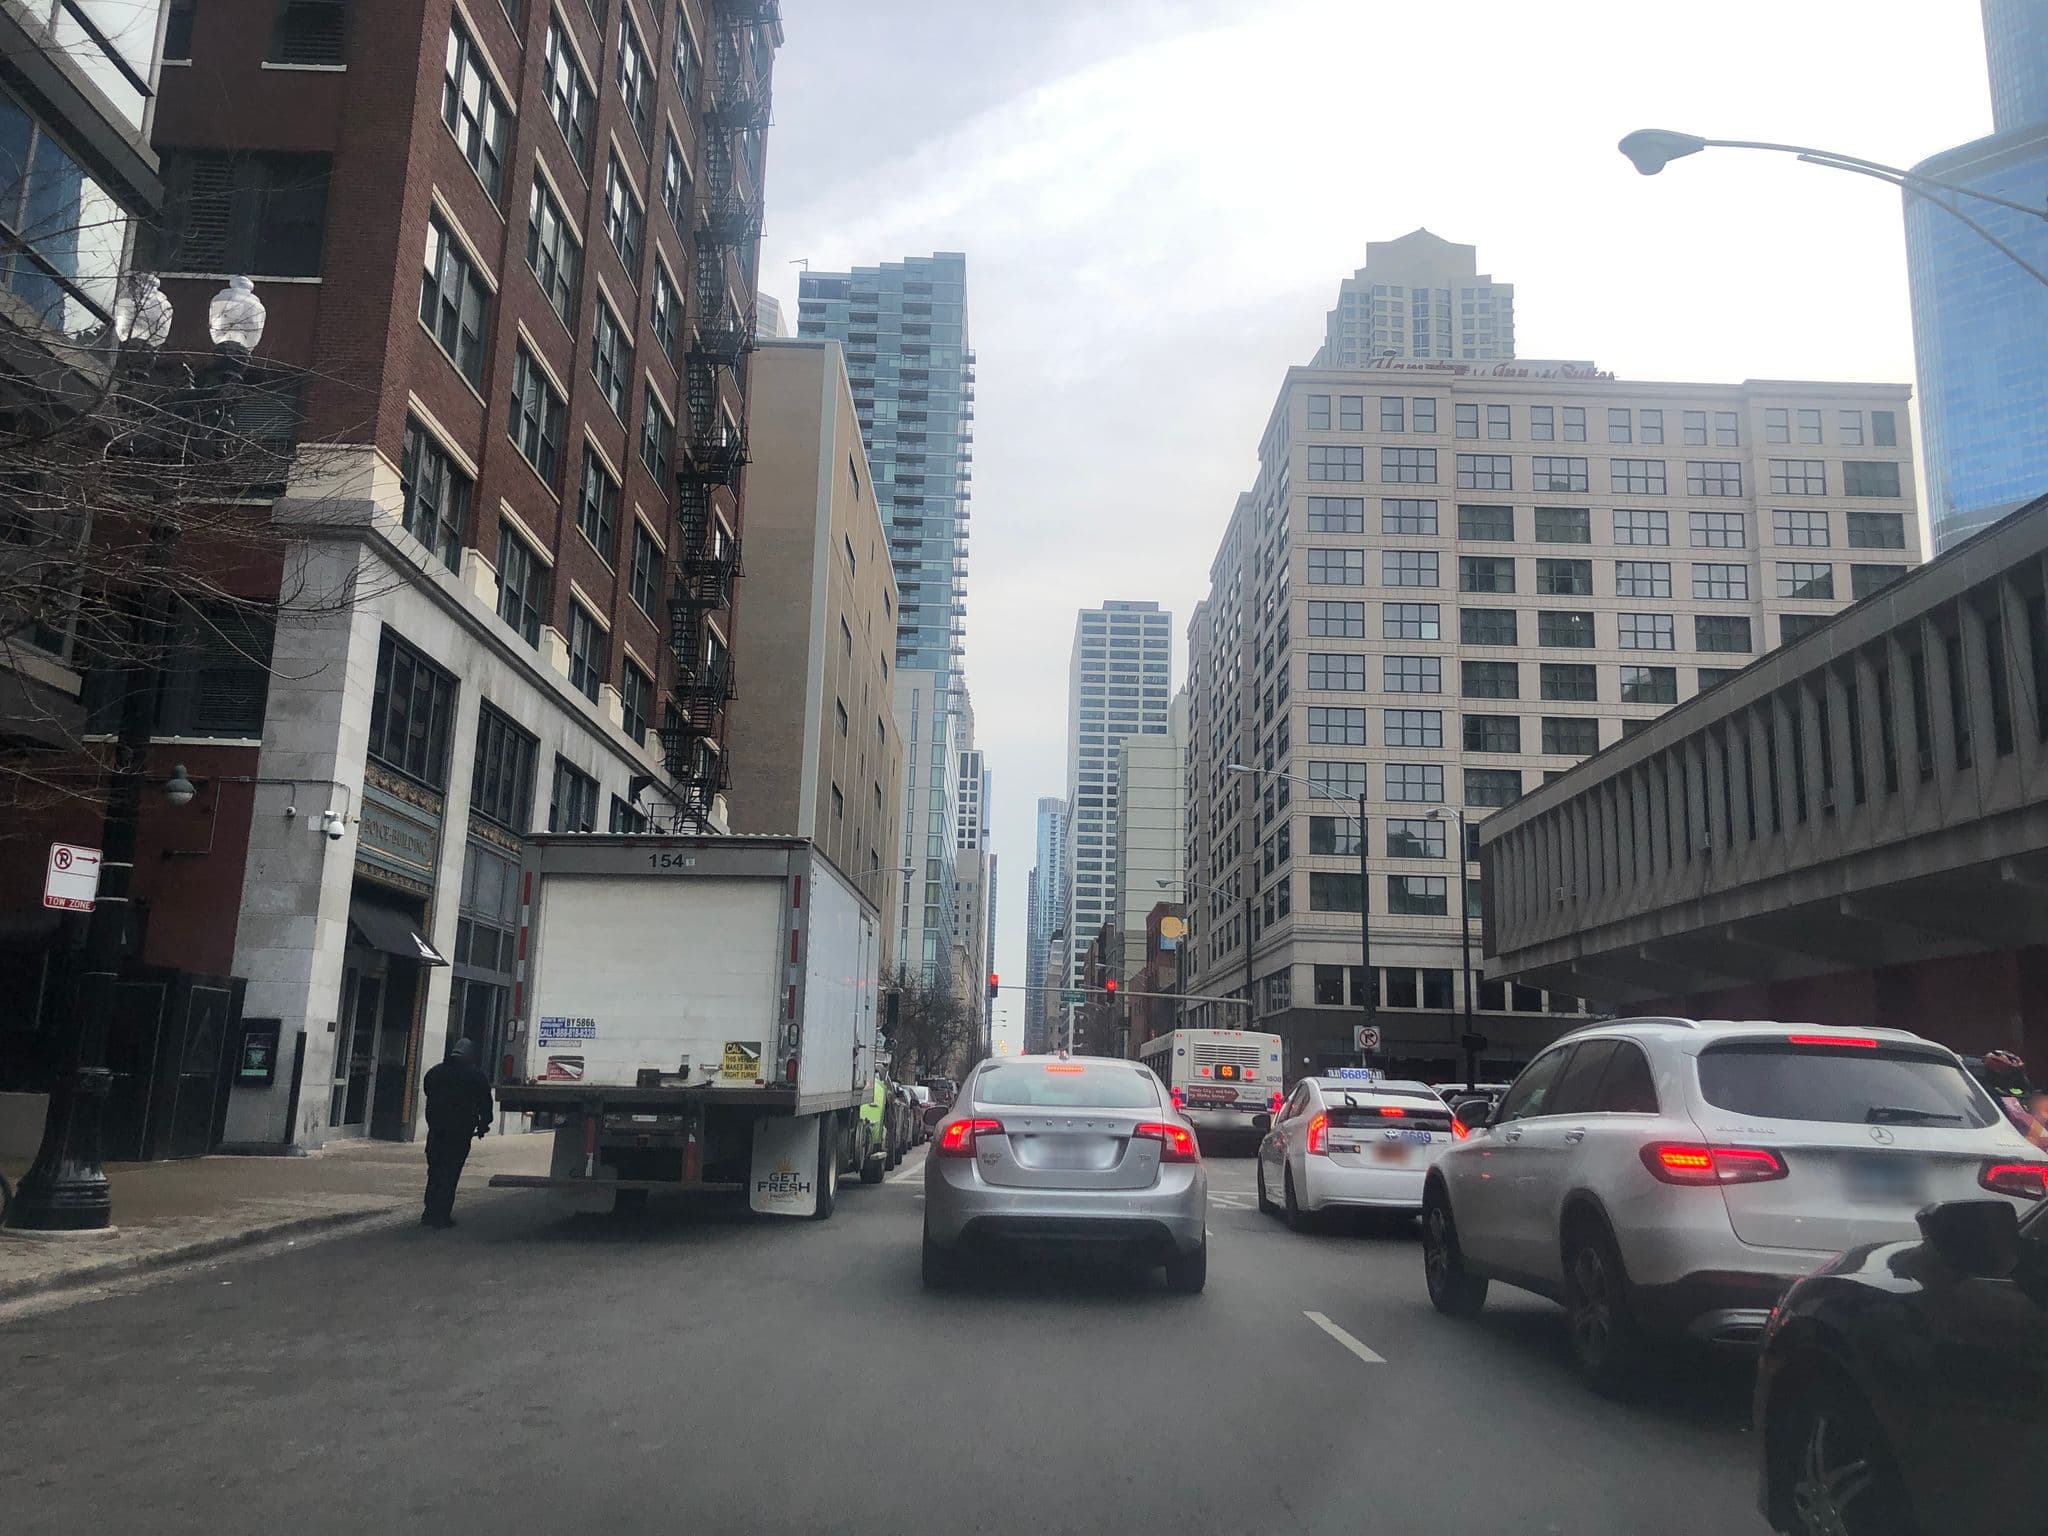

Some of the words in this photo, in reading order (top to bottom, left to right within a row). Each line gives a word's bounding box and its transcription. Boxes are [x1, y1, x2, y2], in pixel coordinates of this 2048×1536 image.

[649, 853, 684, 868] 154
[48, 897, 66, 906] TOW
[69, 900, 91, 909] ZONE
[541, 1028, 553, 1037] CALL
[726, 1063, 744, 1071] MAKES
[744, 1063, 758, 1071] WIDE
[1221, 1066, 1233, 1077] 65
[741, 1071, 758, 1079] TURNS
[1327, 1069, 1341, 1078] TAXI
[1341, 1069, 1368, 1080] 6689
[1024, 1119, 1115, 1129] VOLVO
[1400, 1130, 1432, 1144] 6689
[769, 1172, 800, 1182] GET
[757, 1181, 810, 1193] FRESH
